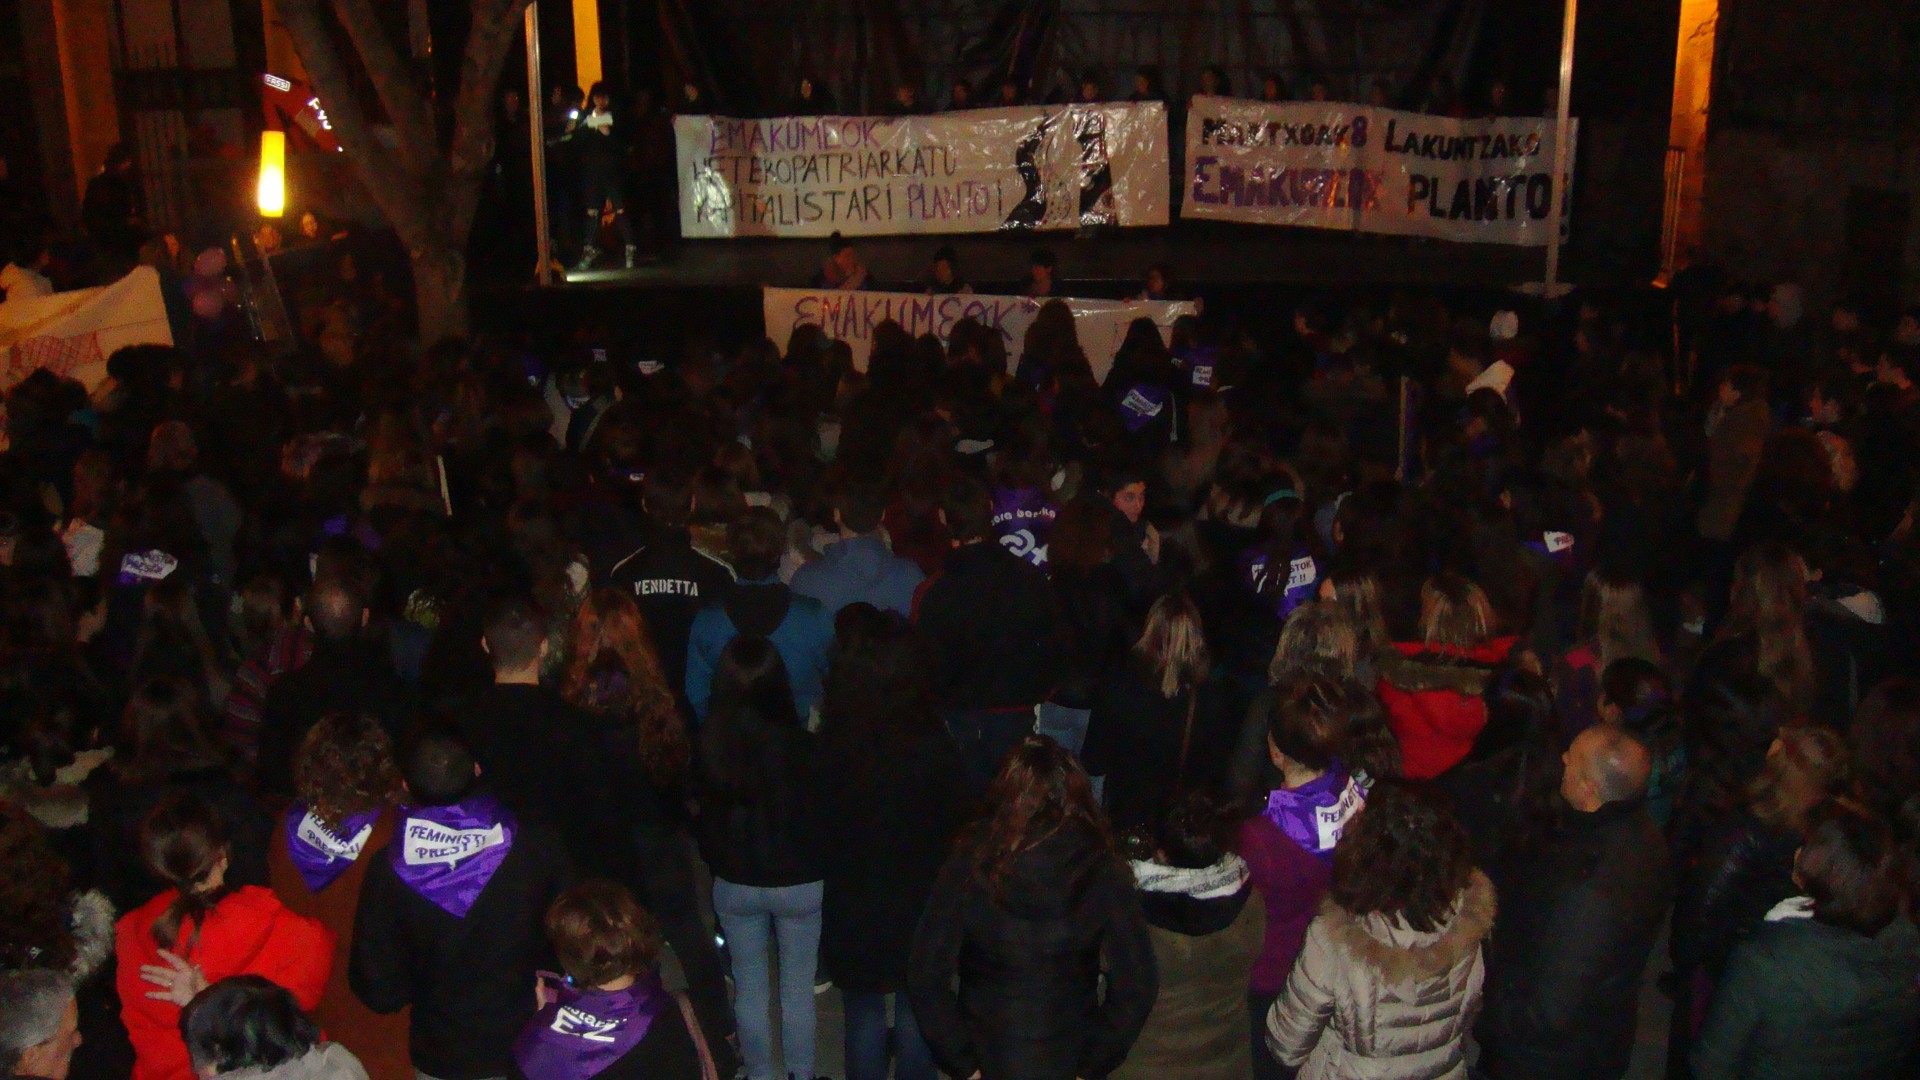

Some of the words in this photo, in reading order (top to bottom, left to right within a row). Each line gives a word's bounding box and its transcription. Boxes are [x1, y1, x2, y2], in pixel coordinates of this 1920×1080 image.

[1385, 119, 1541, 161] LAKUNTZAKO
[634, 579, 699, 597] VENDETTA
[550, 1006, 615, 1042] EZ
